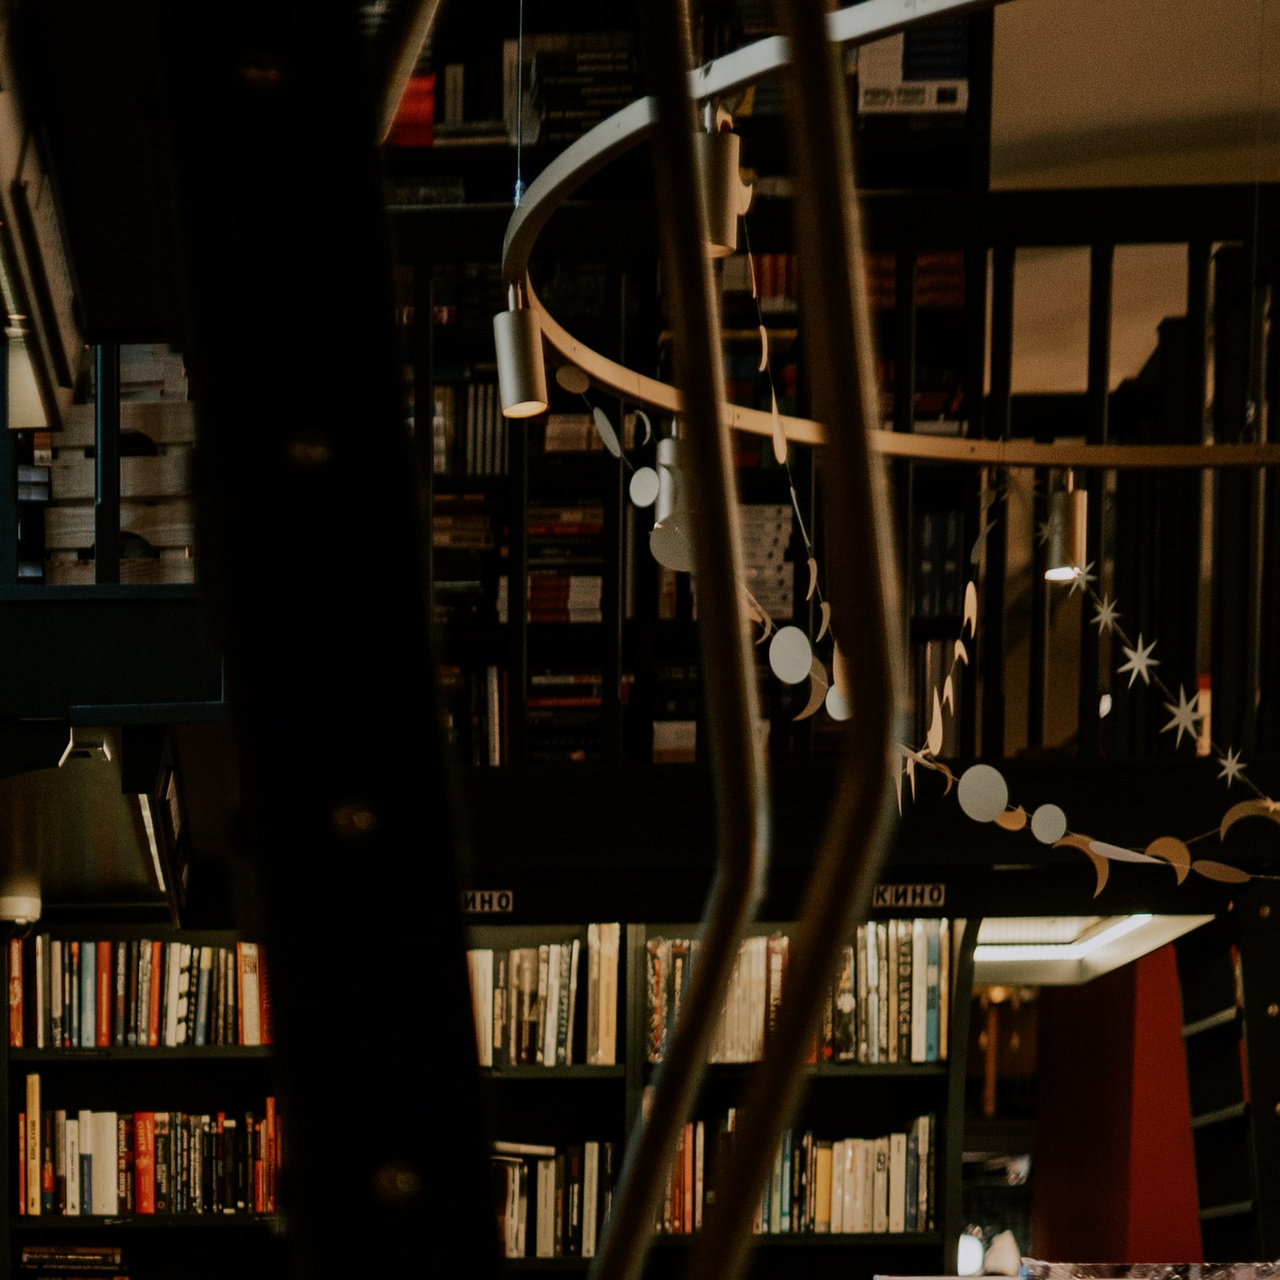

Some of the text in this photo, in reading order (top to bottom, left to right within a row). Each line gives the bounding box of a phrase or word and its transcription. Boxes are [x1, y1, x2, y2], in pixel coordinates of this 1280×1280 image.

[463, 892, 510, 910] ИНО
[876, 885, 942, 903] КИНО
[900, 981, 912, 1034] LYNCH
